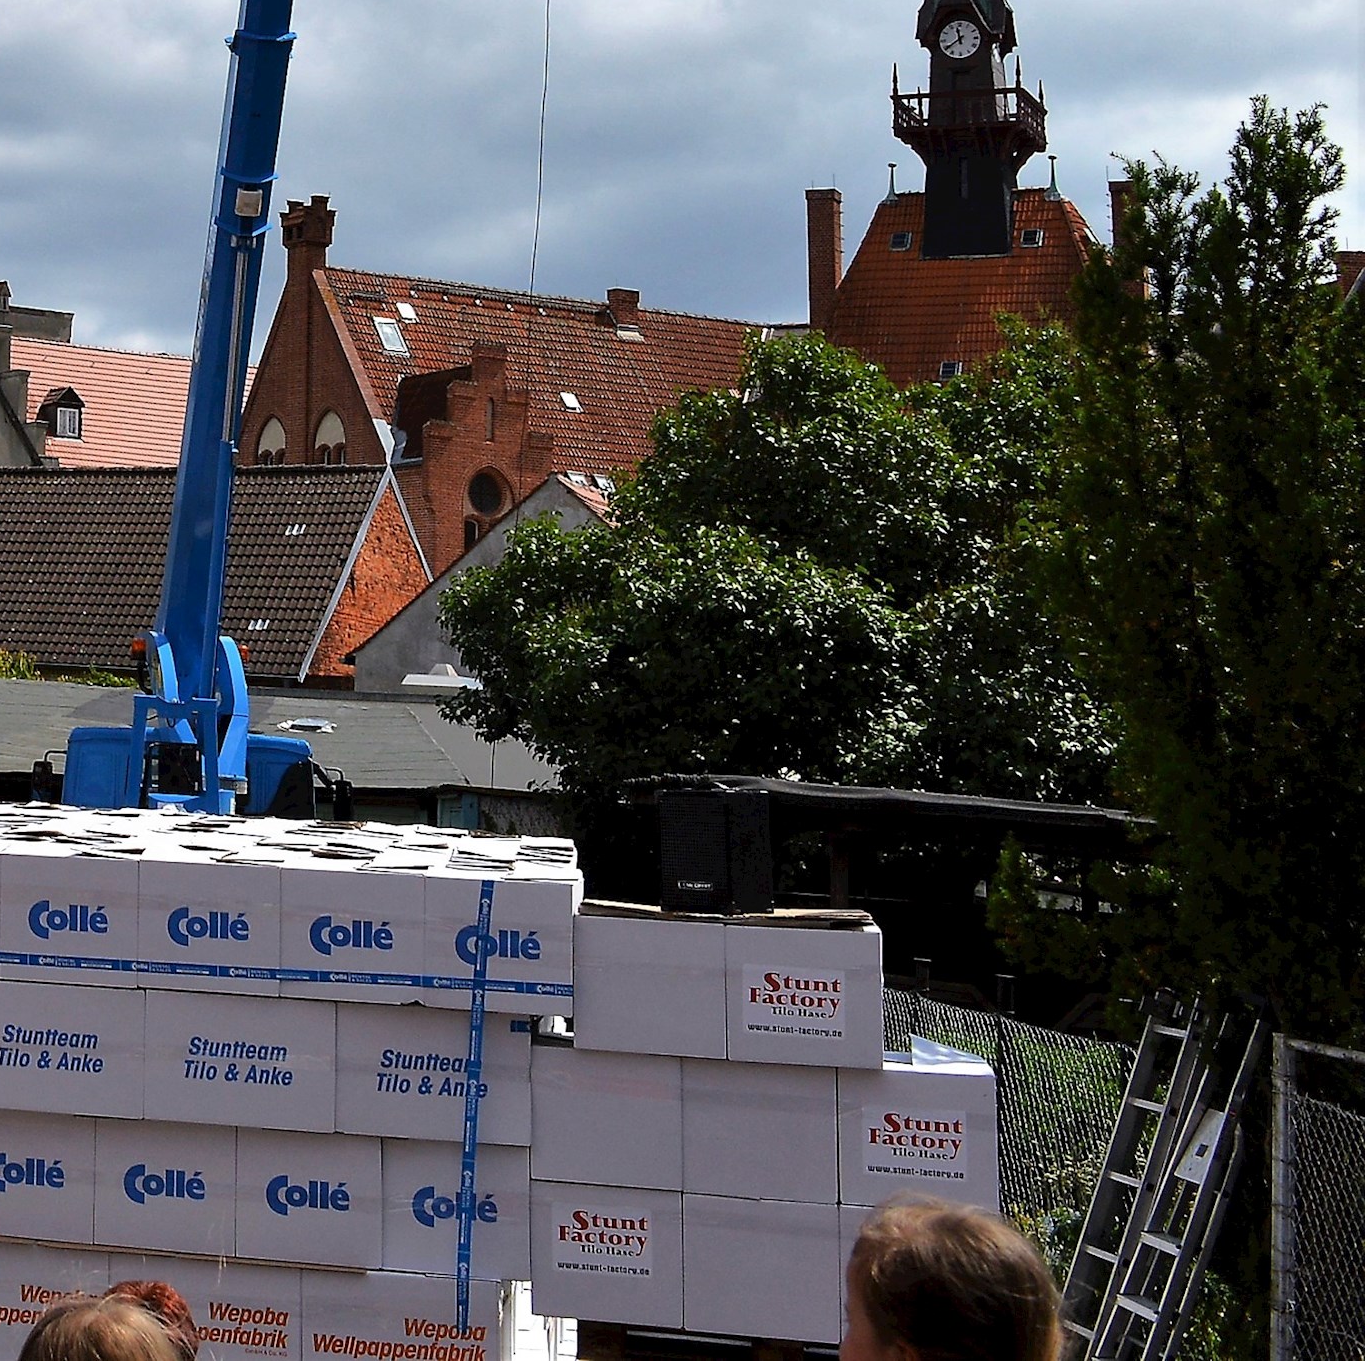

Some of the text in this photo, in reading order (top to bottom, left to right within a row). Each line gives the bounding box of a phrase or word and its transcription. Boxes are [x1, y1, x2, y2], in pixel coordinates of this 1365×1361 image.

[29, 900, 109, 940] Collé
[168, 907, 249, 947] Collé
[310, 915, 394, 956] Collé
[763, 972, 841, 993] Stunt
[749, 987, 840, 1019] Factory
[771, 1006, 827, 1019] Tilo Hase
[2, 1024, 98, 1049] Stuntteam
[747, 1023, 843, 1038] www.stunt-factory.de
[37, 1050, 52, 1069] &
[56, 1051, 104, 1073] Anke
[188, 1036, 288, 1062] Stuntteam
[184, 1059, 293, 1086] Tilo & Anke
[377, 1072, 411, 1093] Tilo
[417, 1075, 433, 1095] &
[883, 1112, 963, 1134] Stunt
[869, 1127, 962, 1160] Factory
[891, 1147, 948, 1160] Tilo Hase
[123, 1163, 206, 1205] Collé
[867, 1165, 965, 1179] www.stunt-factory.de
[266, 1174, 351, 1216] Collé
[572, 1210, 648, 1231] Stunt
[558, 1225, 647, 1257] Factory
[580, 1244, 635, 1257] Tilo Hase
[557, 1261, 650, 1276] www.stunt-factory.de
[209, 1301, 289, 1327] Wepoba
[195, 1326, 288, 1349] penfabrik
[313, 1333, 486, 1361] Wellpappenfabrik
